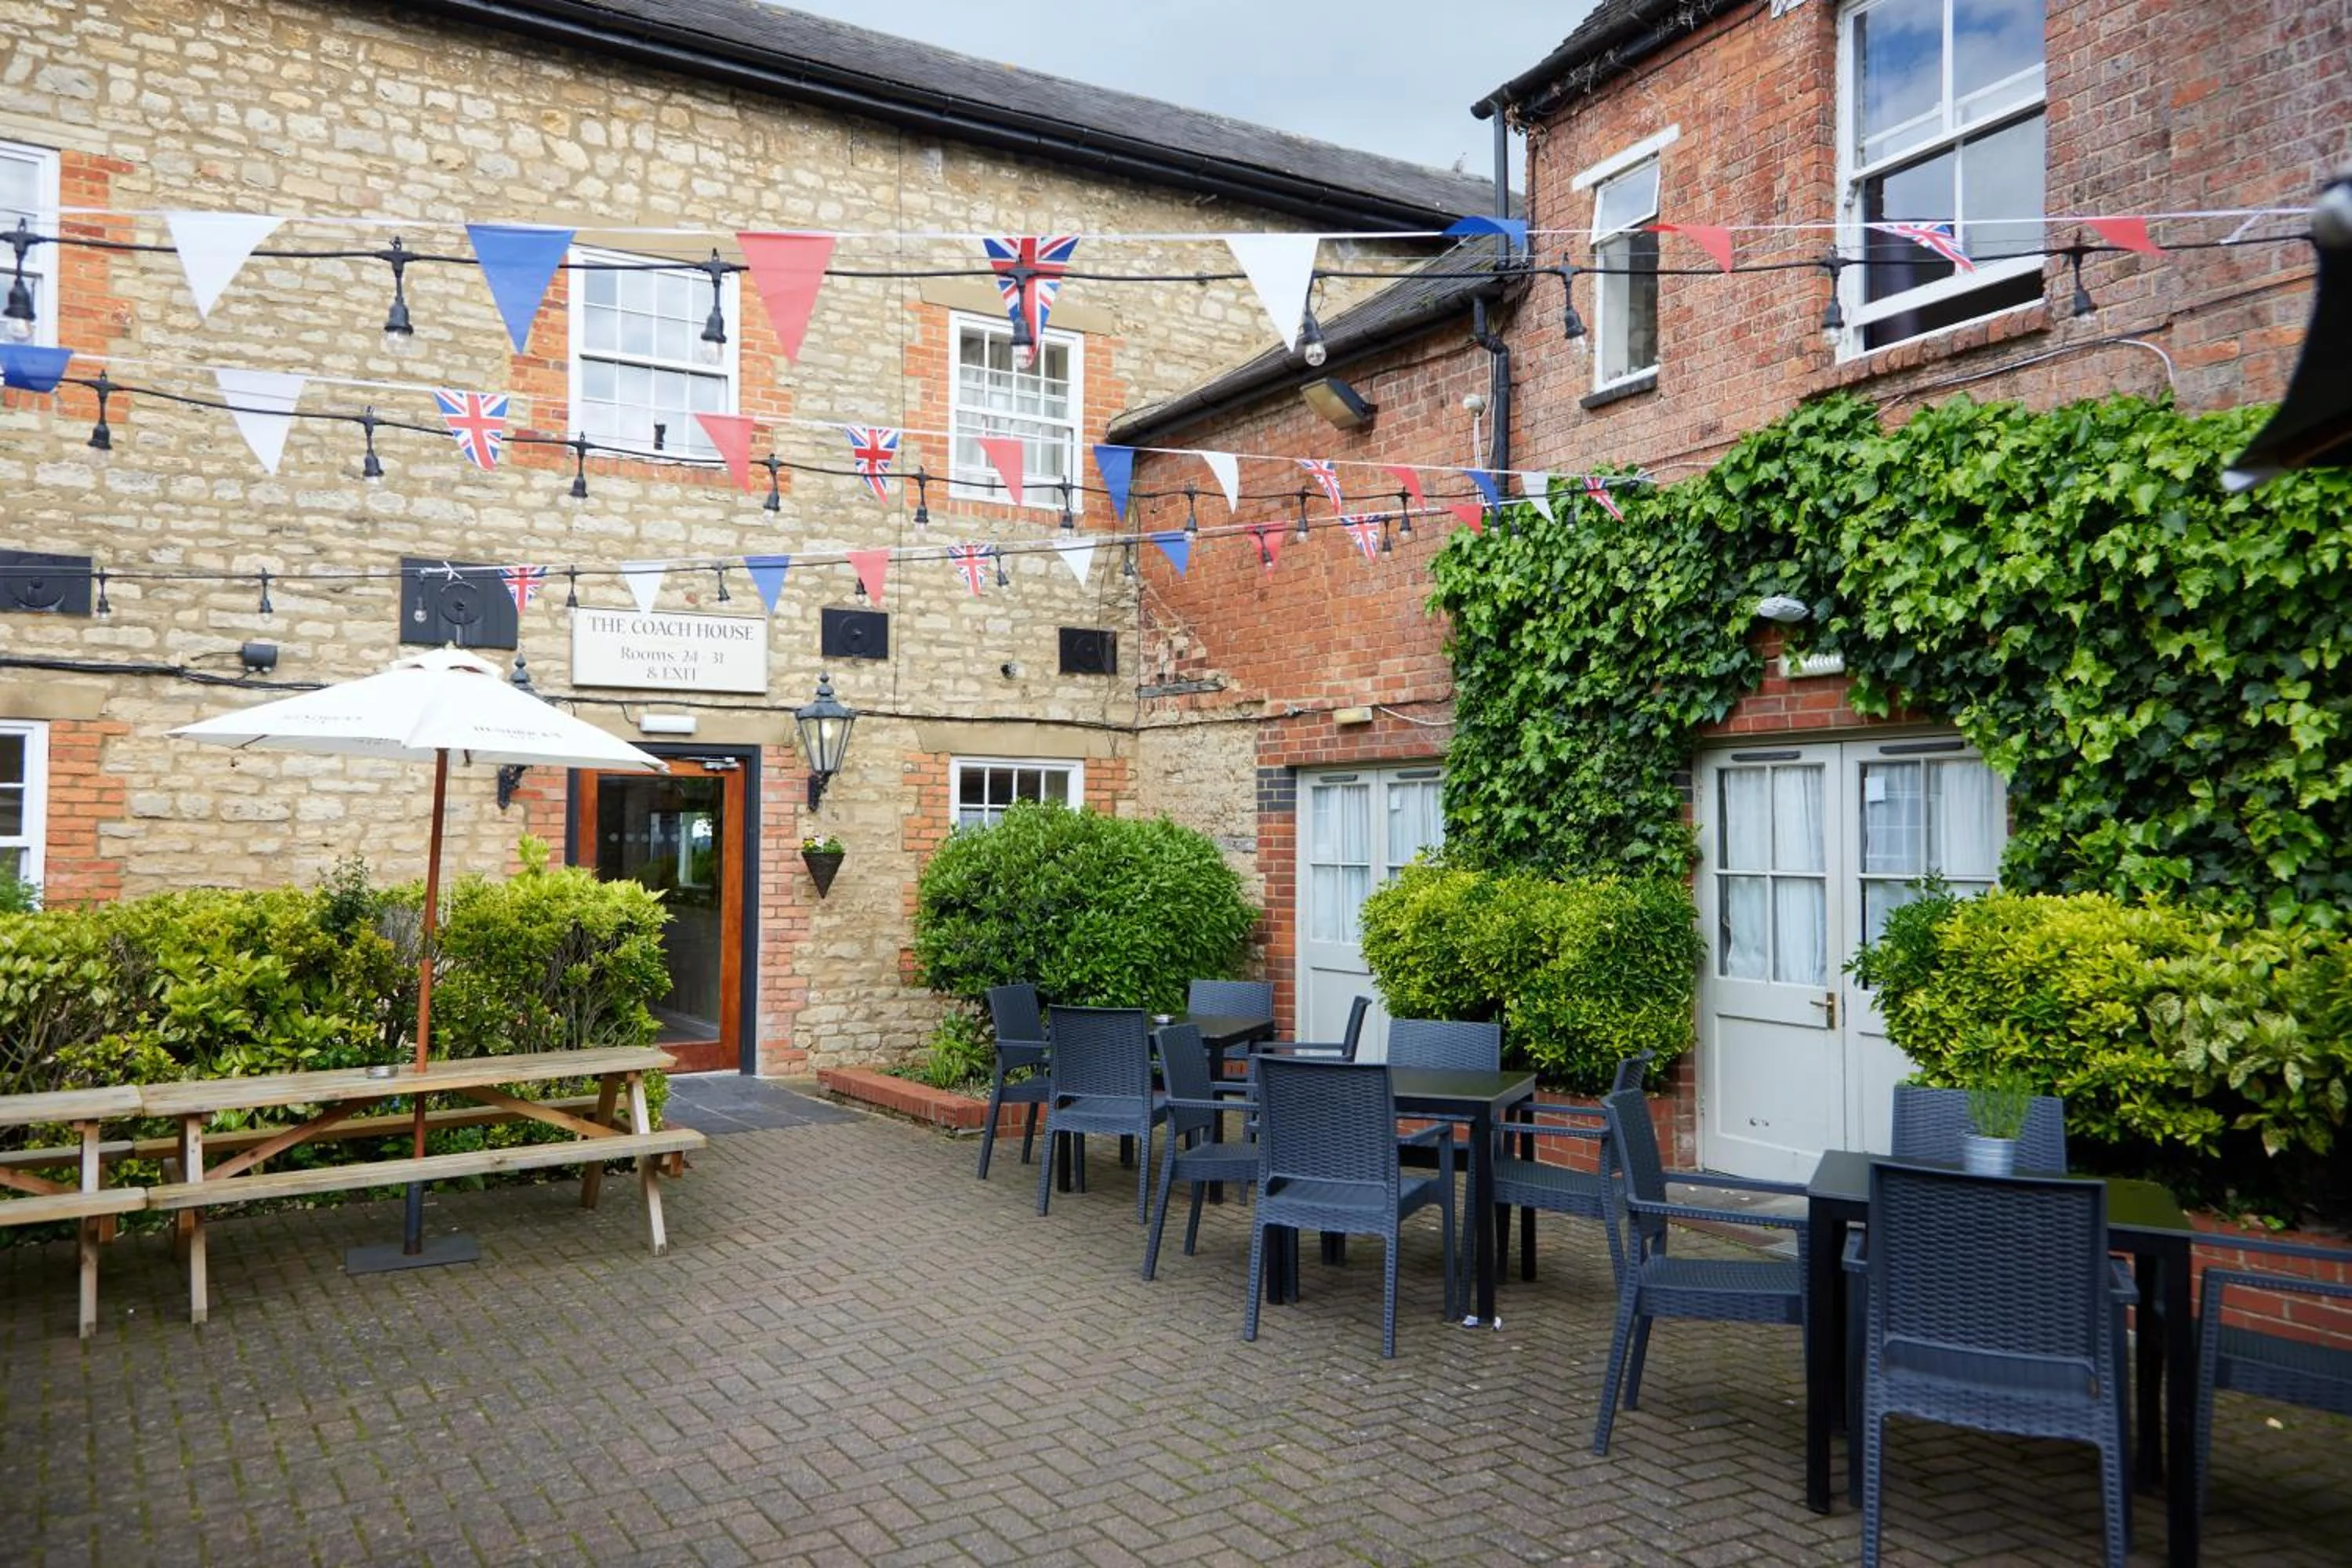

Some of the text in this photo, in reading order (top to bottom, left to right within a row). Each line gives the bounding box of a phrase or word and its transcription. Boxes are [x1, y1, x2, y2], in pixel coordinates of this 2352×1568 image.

[590, 617, 753, 641] THE COACH HOUSE
[621, 645, 675, 661] Rooms
[647, 667, 696, 681] & EXIT
